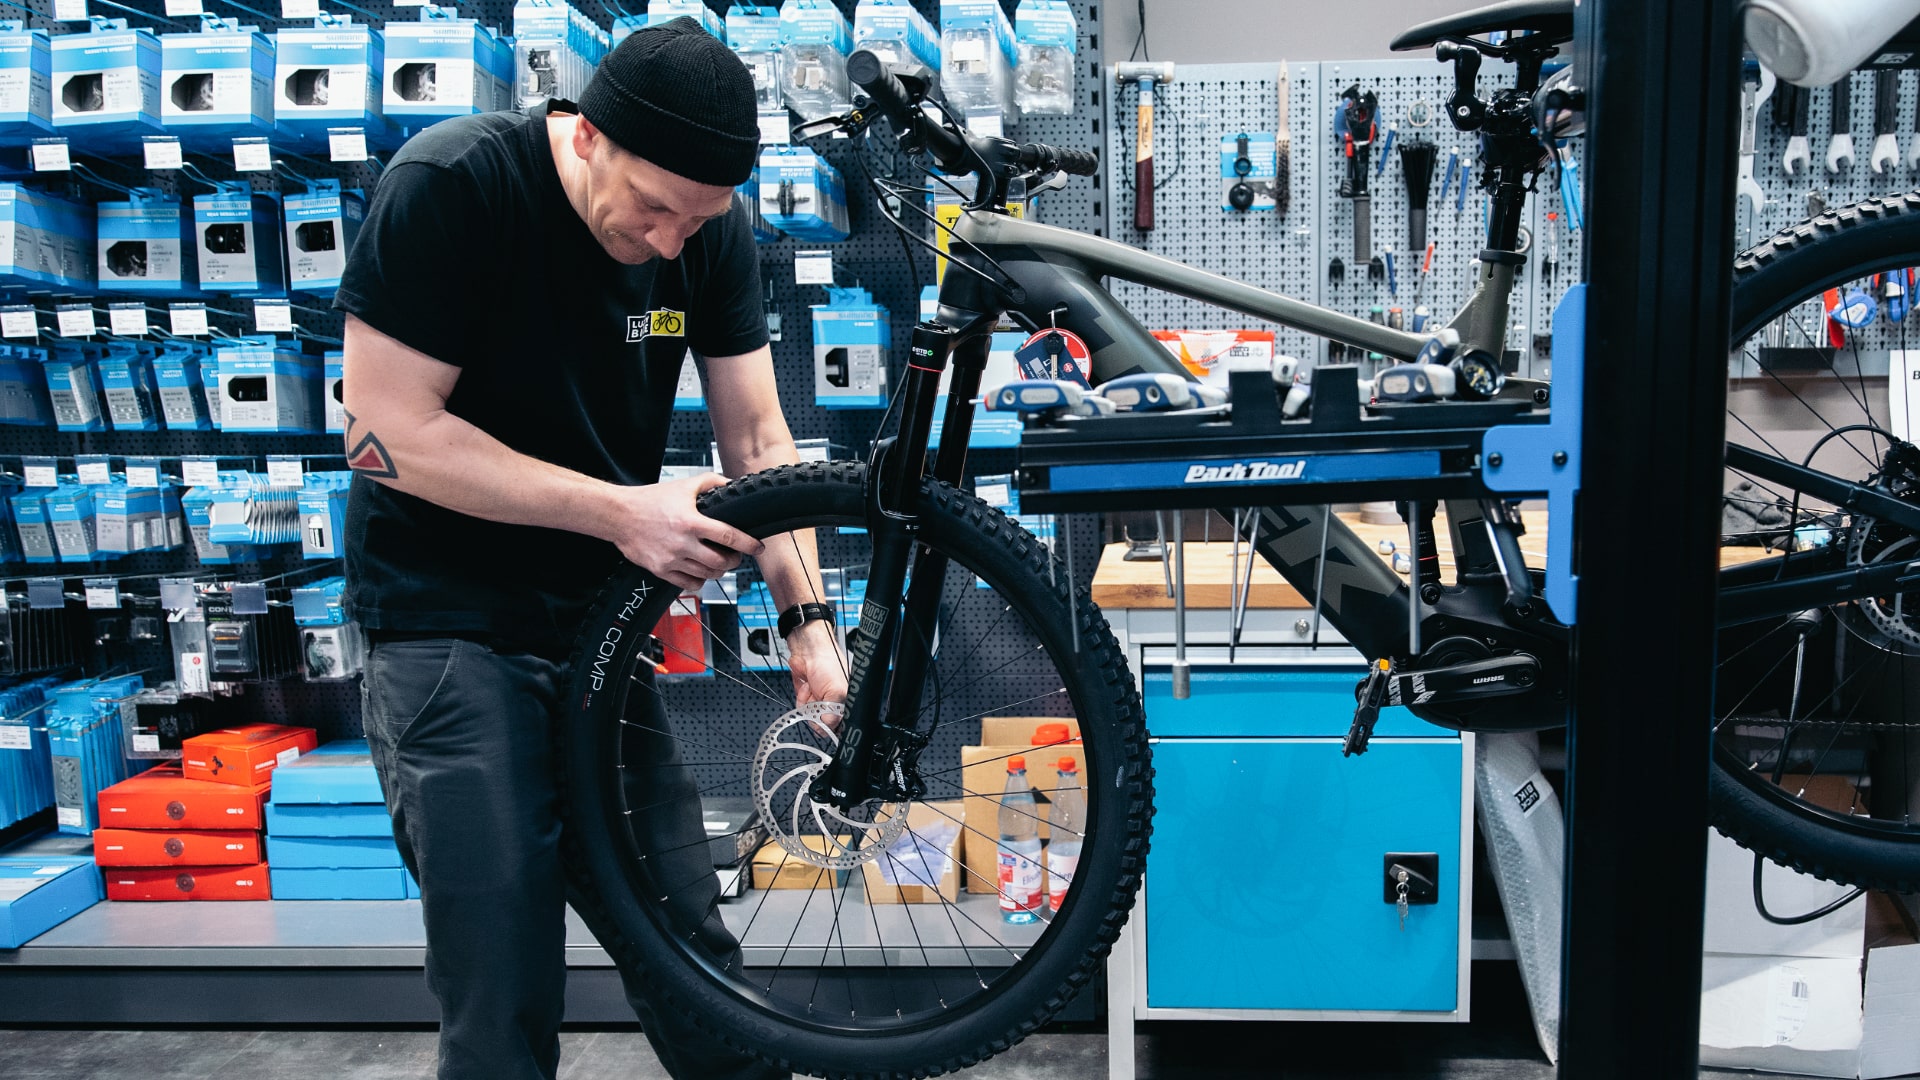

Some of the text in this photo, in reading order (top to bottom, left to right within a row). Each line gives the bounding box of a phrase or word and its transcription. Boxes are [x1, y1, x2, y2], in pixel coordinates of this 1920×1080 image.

[864, 602, 885, 622] ROCK
[590, 580, 654, 691] XR4 COMP
[860, 615, 880, 636] SHOX
[1473, 674, 1505, 684] SRAM
[839, 726, 863, 765] 35
